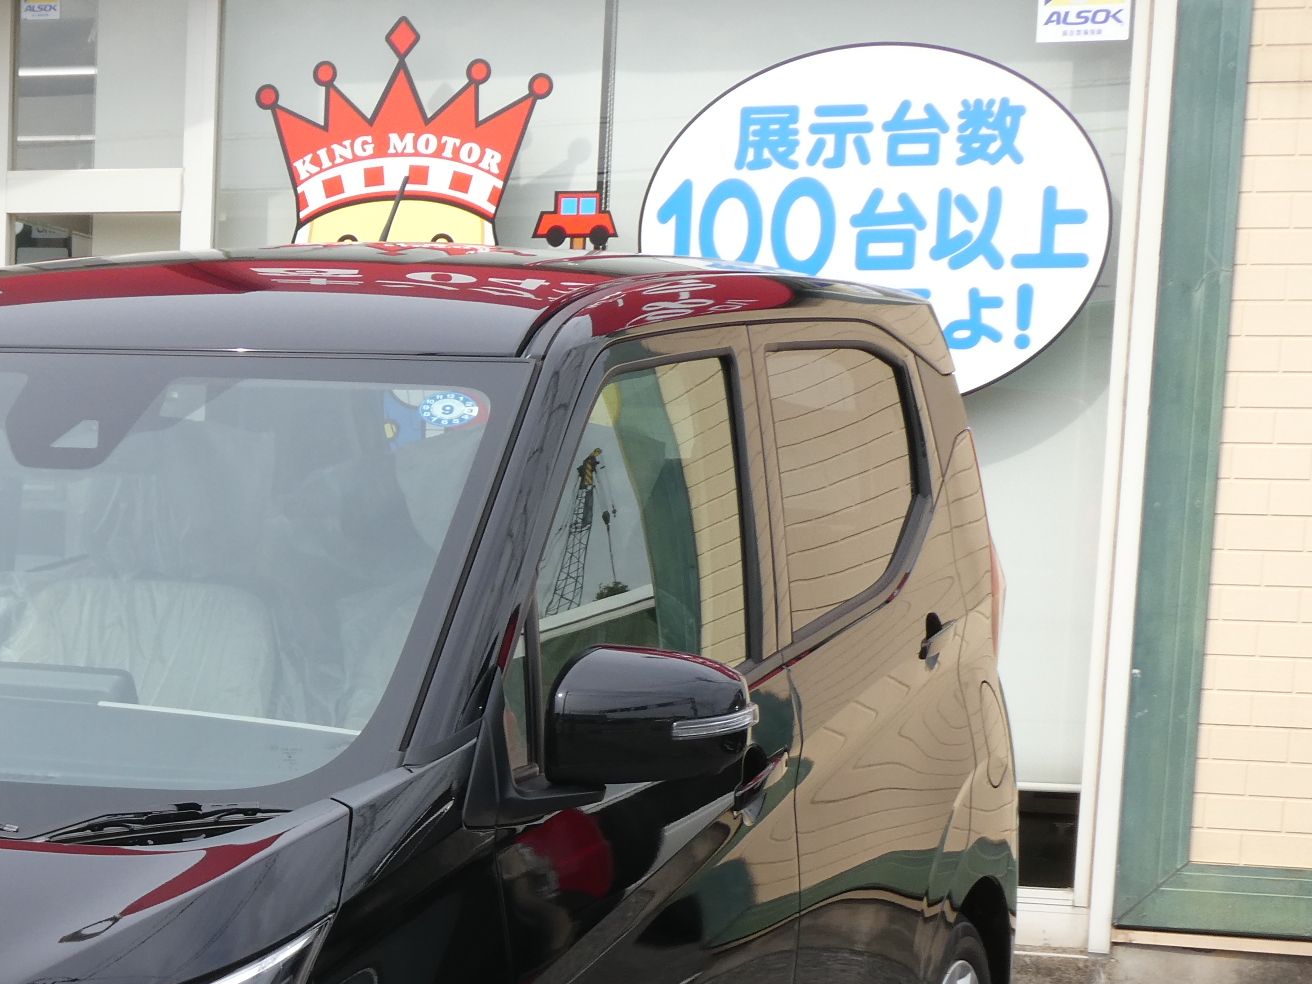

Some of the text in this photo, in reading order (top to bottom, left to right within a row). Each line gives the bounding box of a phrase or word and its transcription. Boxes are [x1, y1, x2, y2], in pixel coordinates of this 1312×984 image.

[1043, 9, 1124, 25] ALSOK
[293, 132, 503, 181] KING MOTOR
[734, 97, 1027, 171] 展示台数
[656, 176, 1090, 277] 100台以上
[918, 283, 1033, 350] よ!
[441, 404, 455, 416] 9
